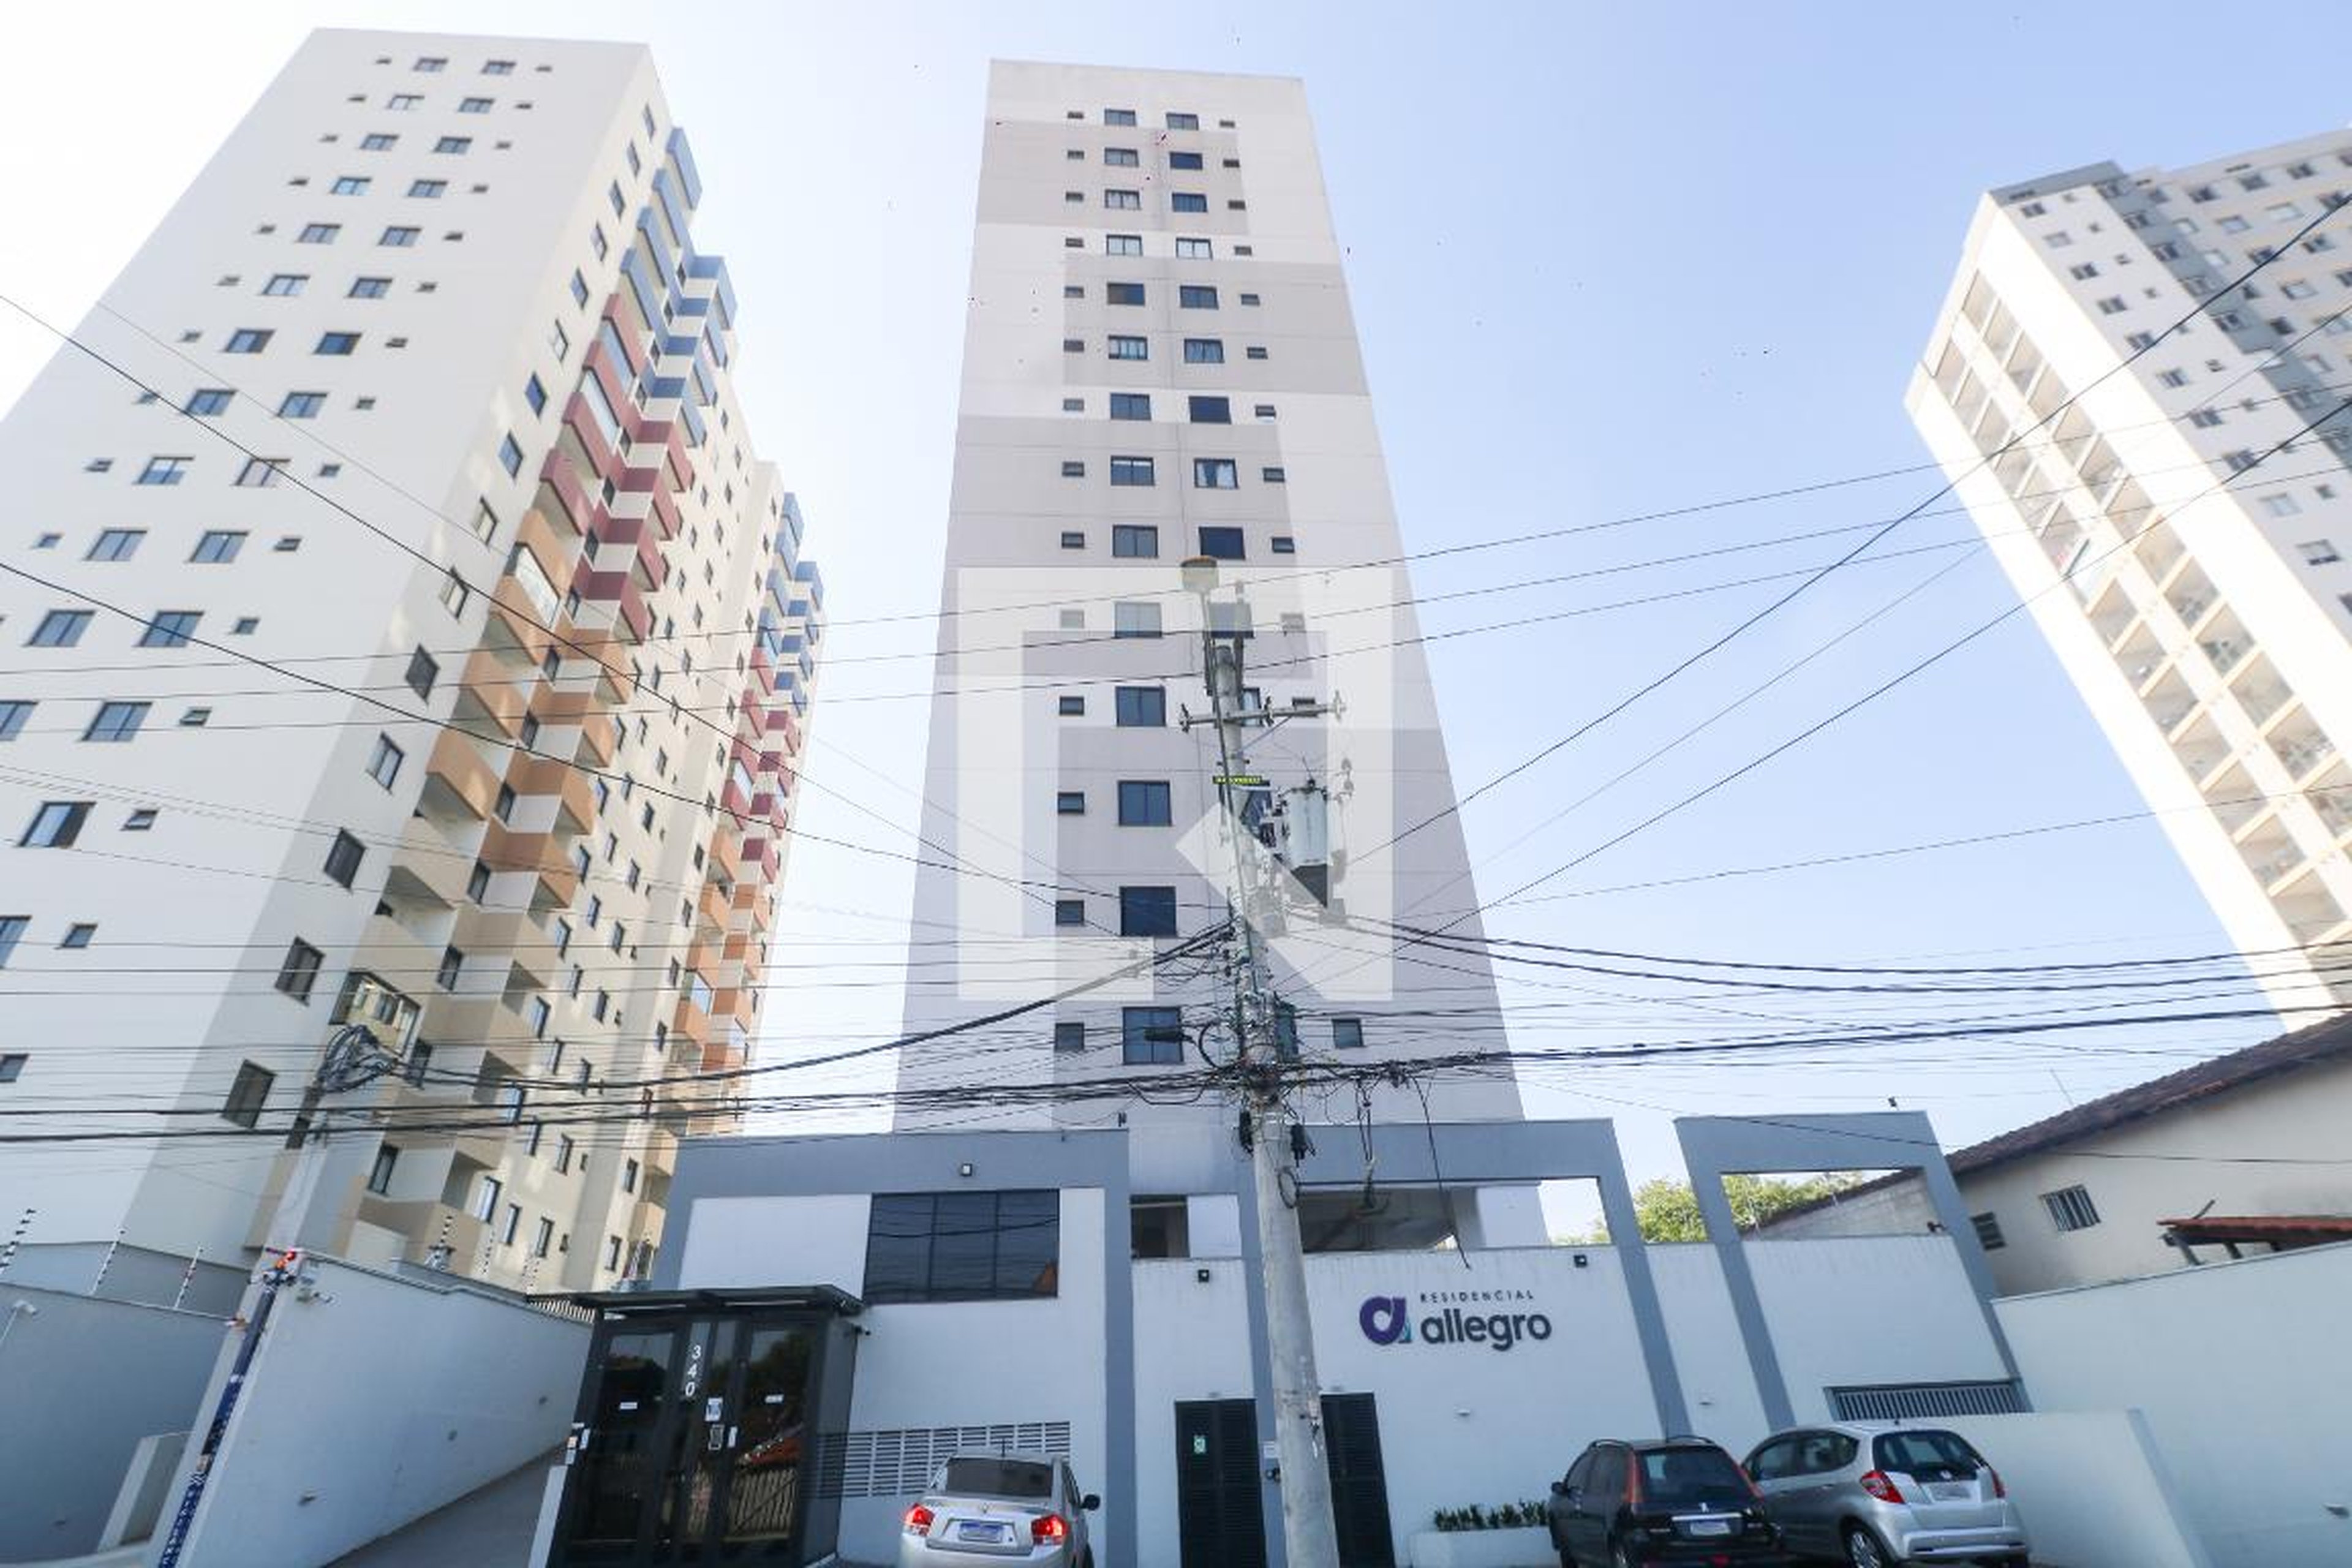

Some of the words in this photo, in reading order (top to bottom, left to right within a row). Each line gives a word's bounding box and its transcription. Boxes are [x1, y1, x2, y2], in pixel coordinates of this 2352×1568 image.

[1420, 1289, 1534, 1303] RESIDENCIAL
[1420, 1308, 1552, 1351] allegro
[685, 1344, 701, 1396] 340
